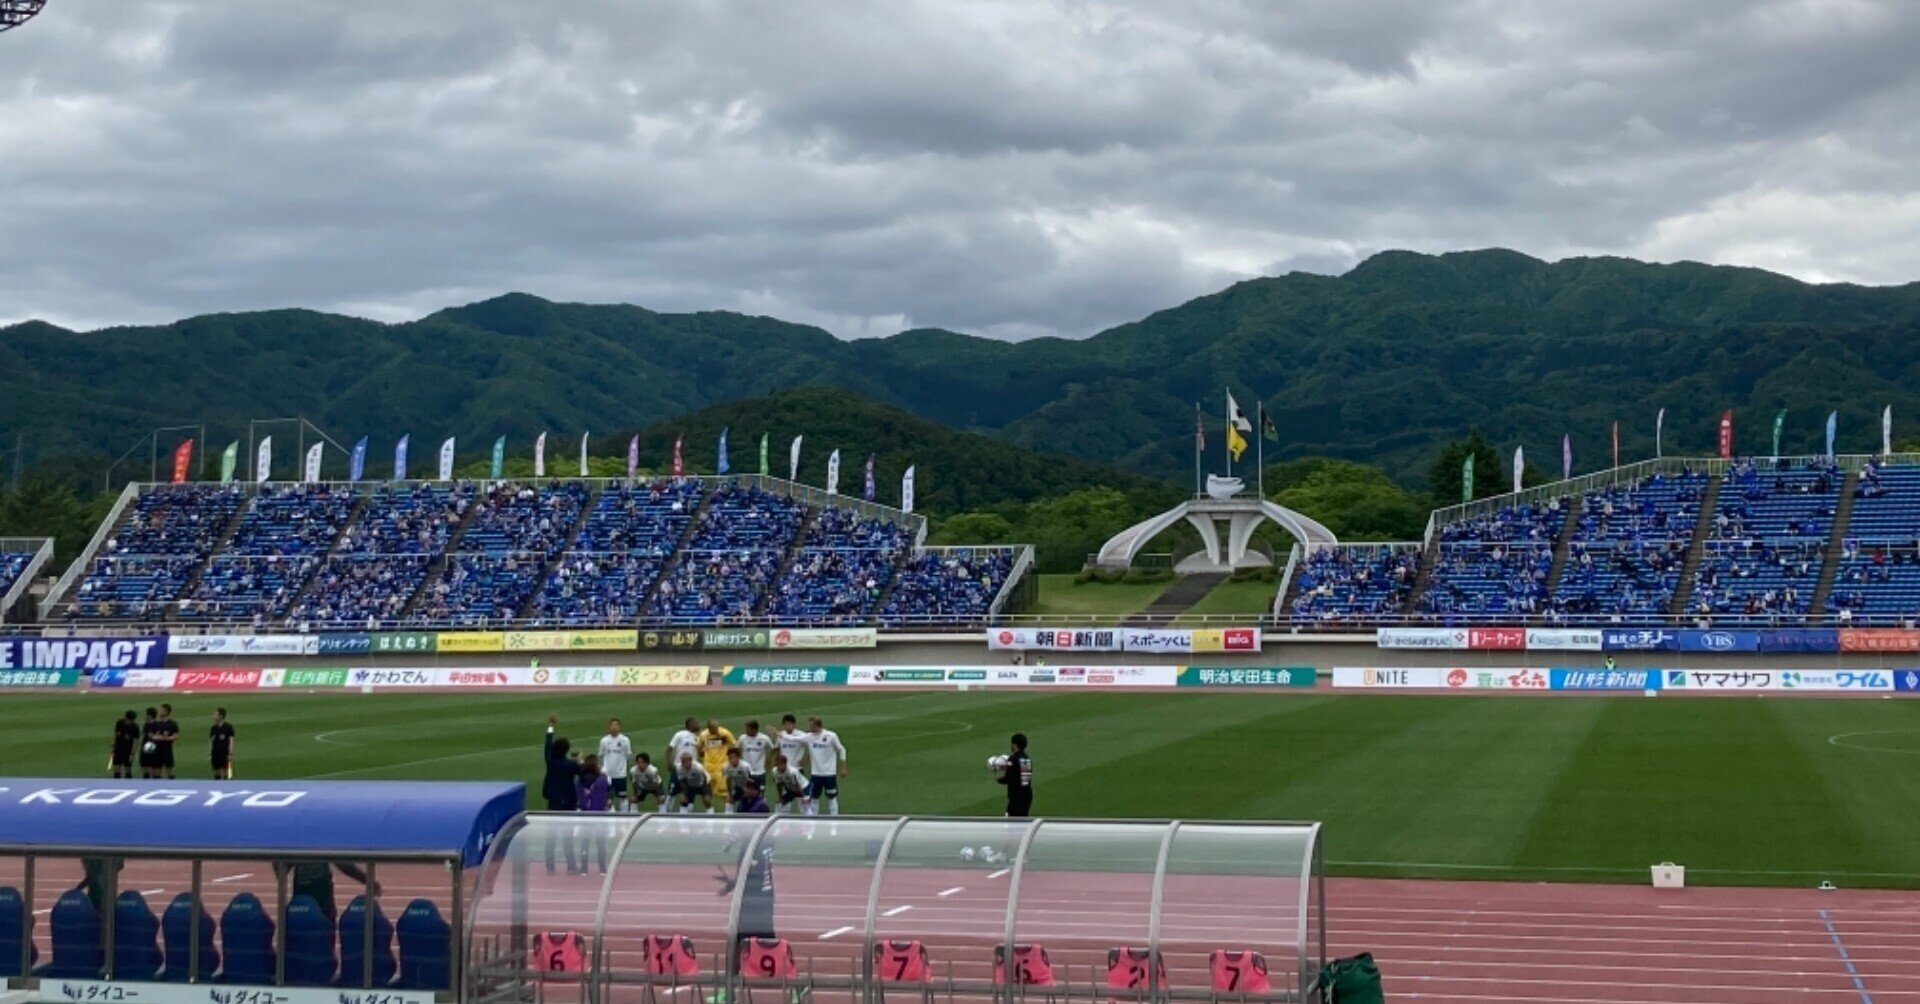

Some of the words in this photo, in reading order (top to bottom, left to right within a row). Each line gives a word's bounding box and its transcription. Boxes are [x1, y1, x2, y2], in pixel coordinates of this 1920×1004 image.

[380, 636, 428, 649] はえぬき
[706, 633, 751, 645] 山形ガス
[1035, 631, 1113, 648] 朝日新聞
[1705, 634, 1733, 647] YBS
[22, 641, 156, 668] IMPACT
[177, 671, 260, 684] デンソーFA山形
[371, 671, 429, 684] かわでん
[743, 668, 828, 682] 明治安田生命
[1199, 669, 1292, 684] 明治安田生命
[1364, 670, 1409, 684] UNITE
[1563, 671, 1649, 687] 山形新聞
[1691, 672, 1771, 687] ヤマサワ
[1835, 672, 1889, 687] ワイム
[19, 787, 308, 807] KOGYO
[550, 950, 566, 972] 6
[760, 955, 776, 977] 9
[893, 957, 909, 981] 7
[1226, 966, 1241, 991] 7
[87, 984, 139, 1000] ダイユー
[235, 990, 289, 1004] ダイユー
